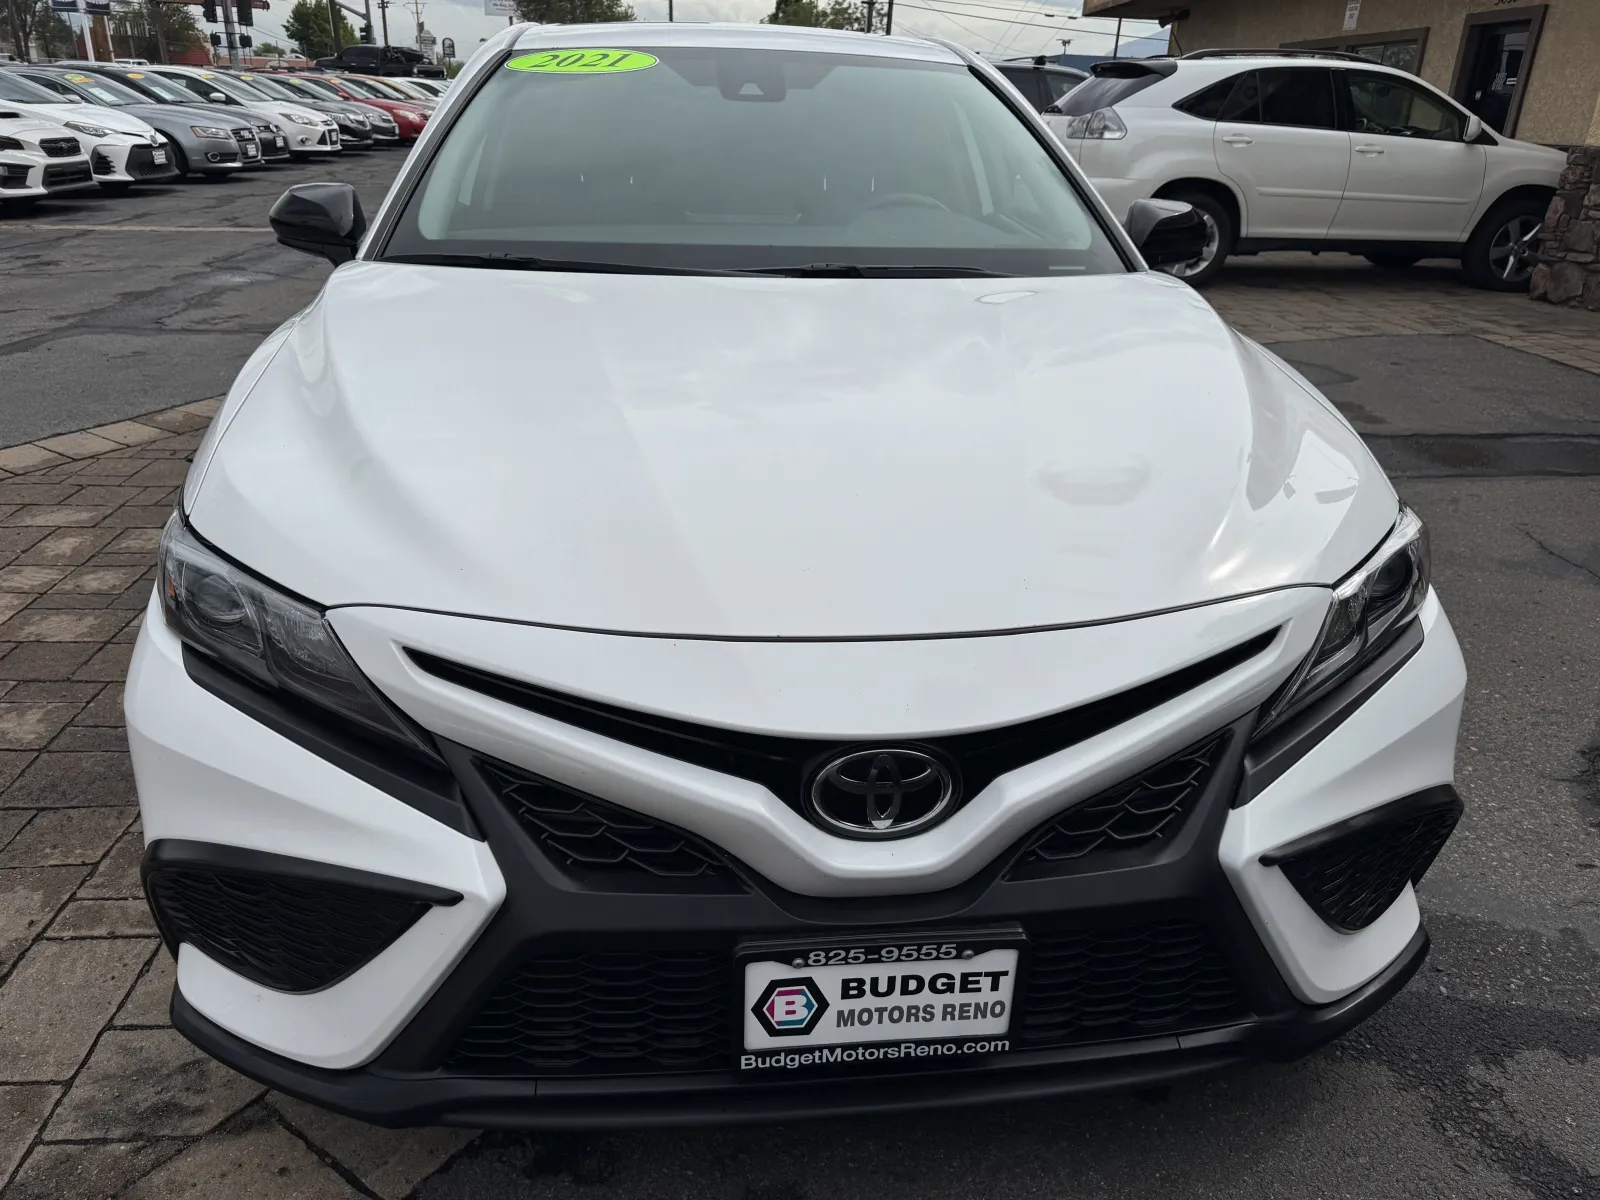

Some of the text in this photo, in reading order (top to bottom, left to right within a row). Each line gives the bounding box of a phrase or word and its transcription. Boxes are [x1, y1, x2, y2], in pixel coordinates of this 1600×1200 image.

[527, 53, 632, 68] 2021
[807, 944, 957, 966] 825-9555
[840, 970, 1009, 1000] BUDGET
[772, 995, 809, 1021] B
[836, 1000, 1006, 1028] MOTORS RENO
[740, 1039, 1010, 1070] BudgetMotorsReno.com
